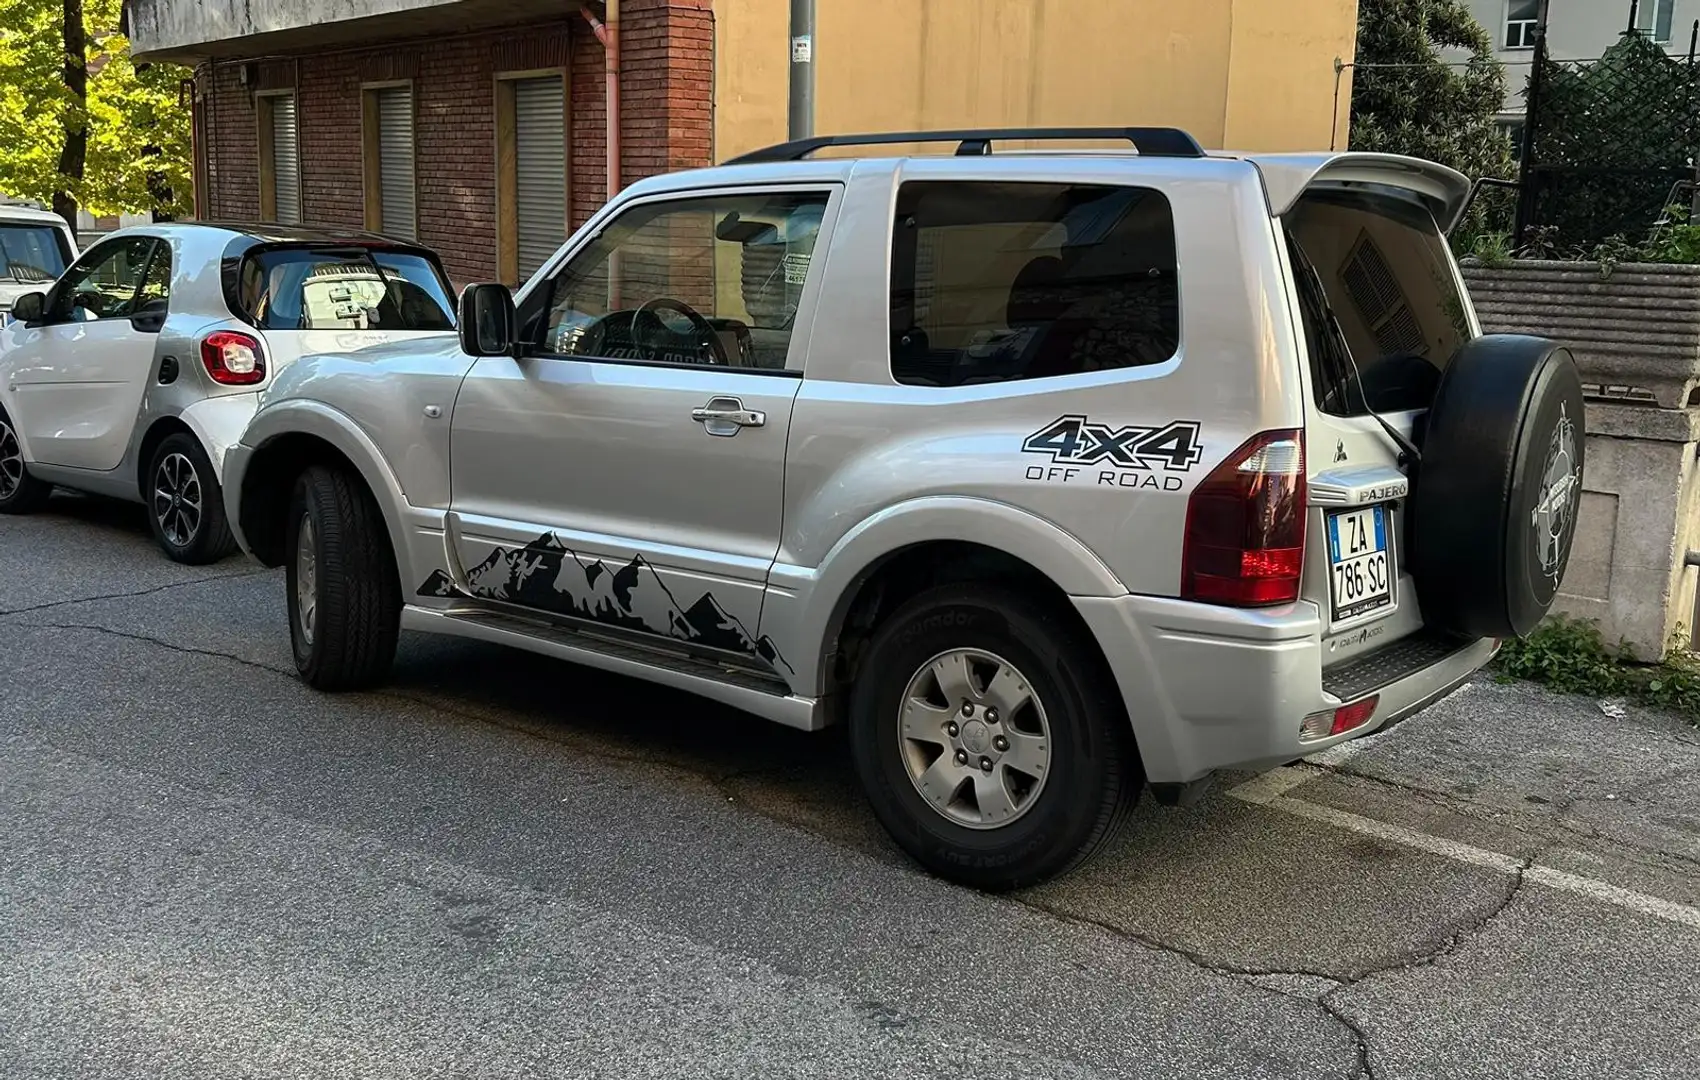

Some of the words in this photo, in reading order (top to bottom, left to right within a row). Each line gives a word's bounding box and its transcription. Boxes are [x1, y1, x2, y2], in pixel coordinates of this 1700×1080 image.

[1025, 466, 1080, 482] OFF
[1098, 470, 1183, 491] ROAD
[1359, 484, 1406, 502] PAJERO
[1347, 514, 1368, 553] ZA
[1336, 561, 1364, 603] 786
[1367, 555, 1386, 593] SC
